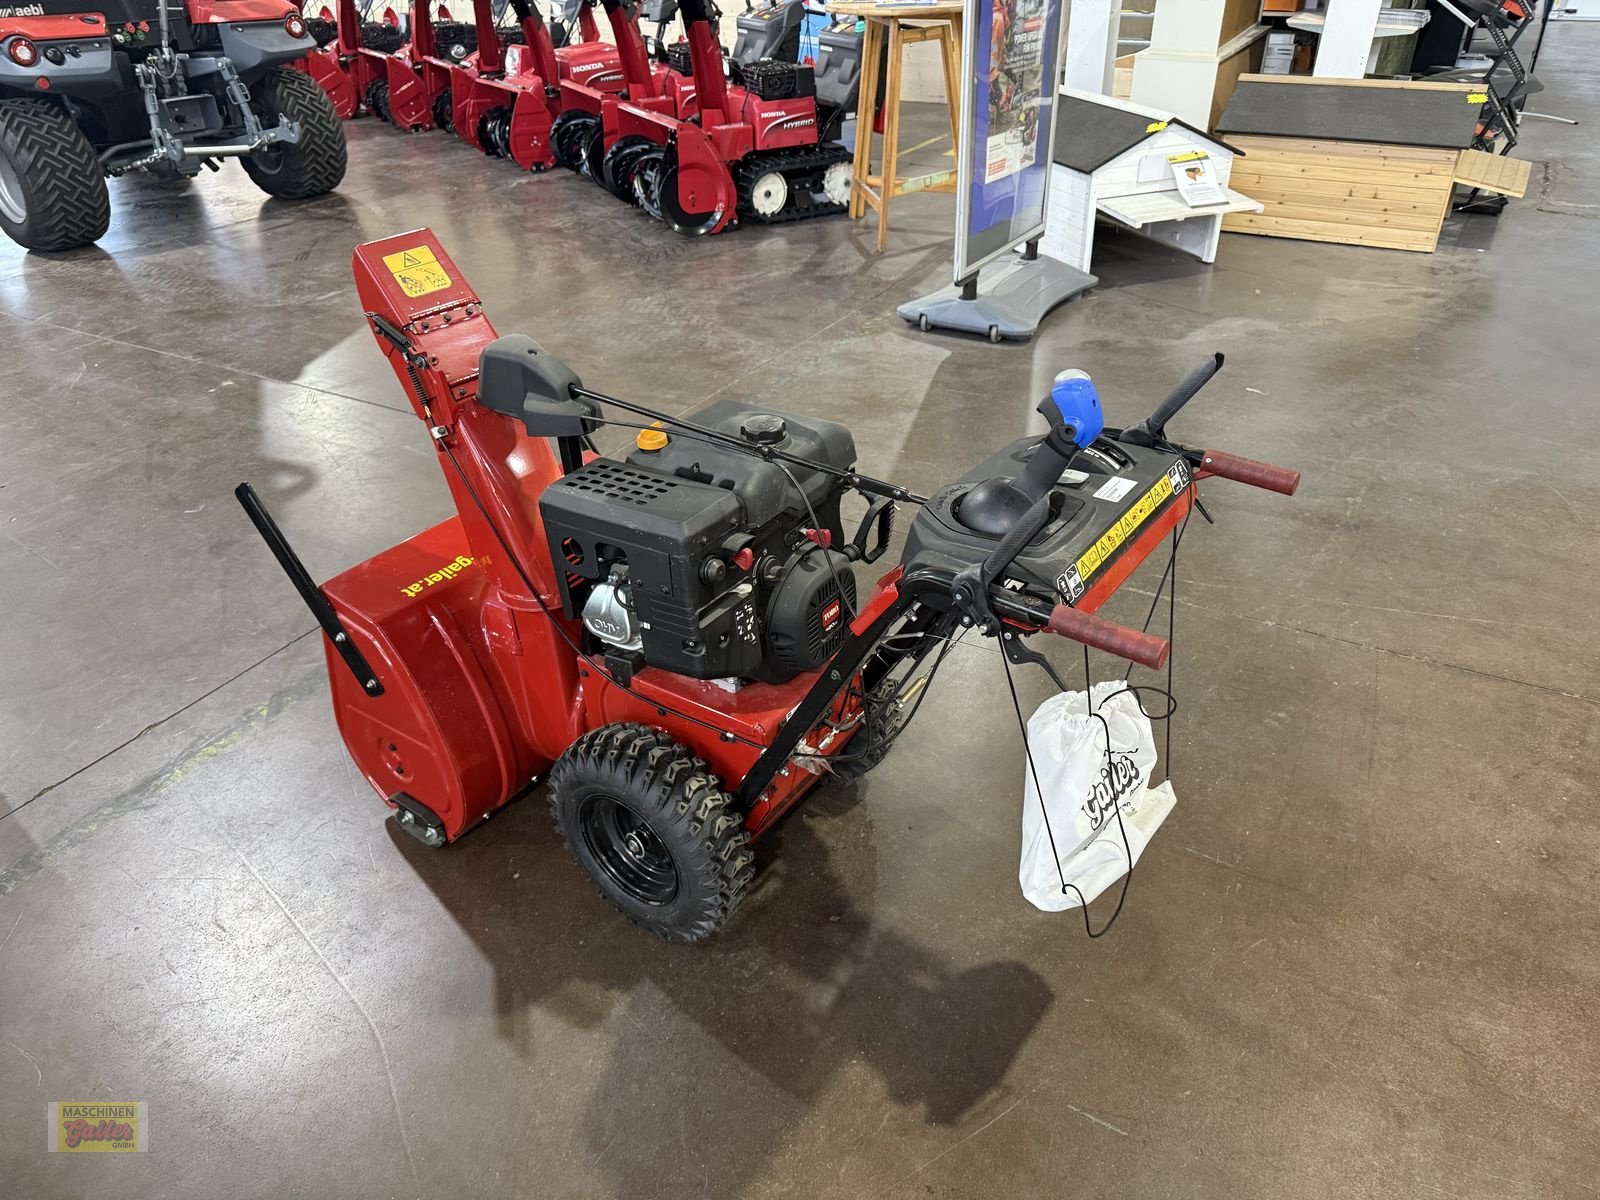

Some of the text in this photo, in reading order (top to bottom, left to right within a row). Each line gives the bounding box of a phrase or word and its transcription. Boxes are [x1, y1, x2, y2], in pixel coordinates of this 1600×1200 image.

[15, 4, 44, 16] aebi
[572, 62, 604, 73] HONDA
[760, 110, 786, 119] HONDA
[783, 118, 814, 129] HYBRID
[823, 604, 840, 621] TORO
[1081, 755, 1140, 831] Gailer
